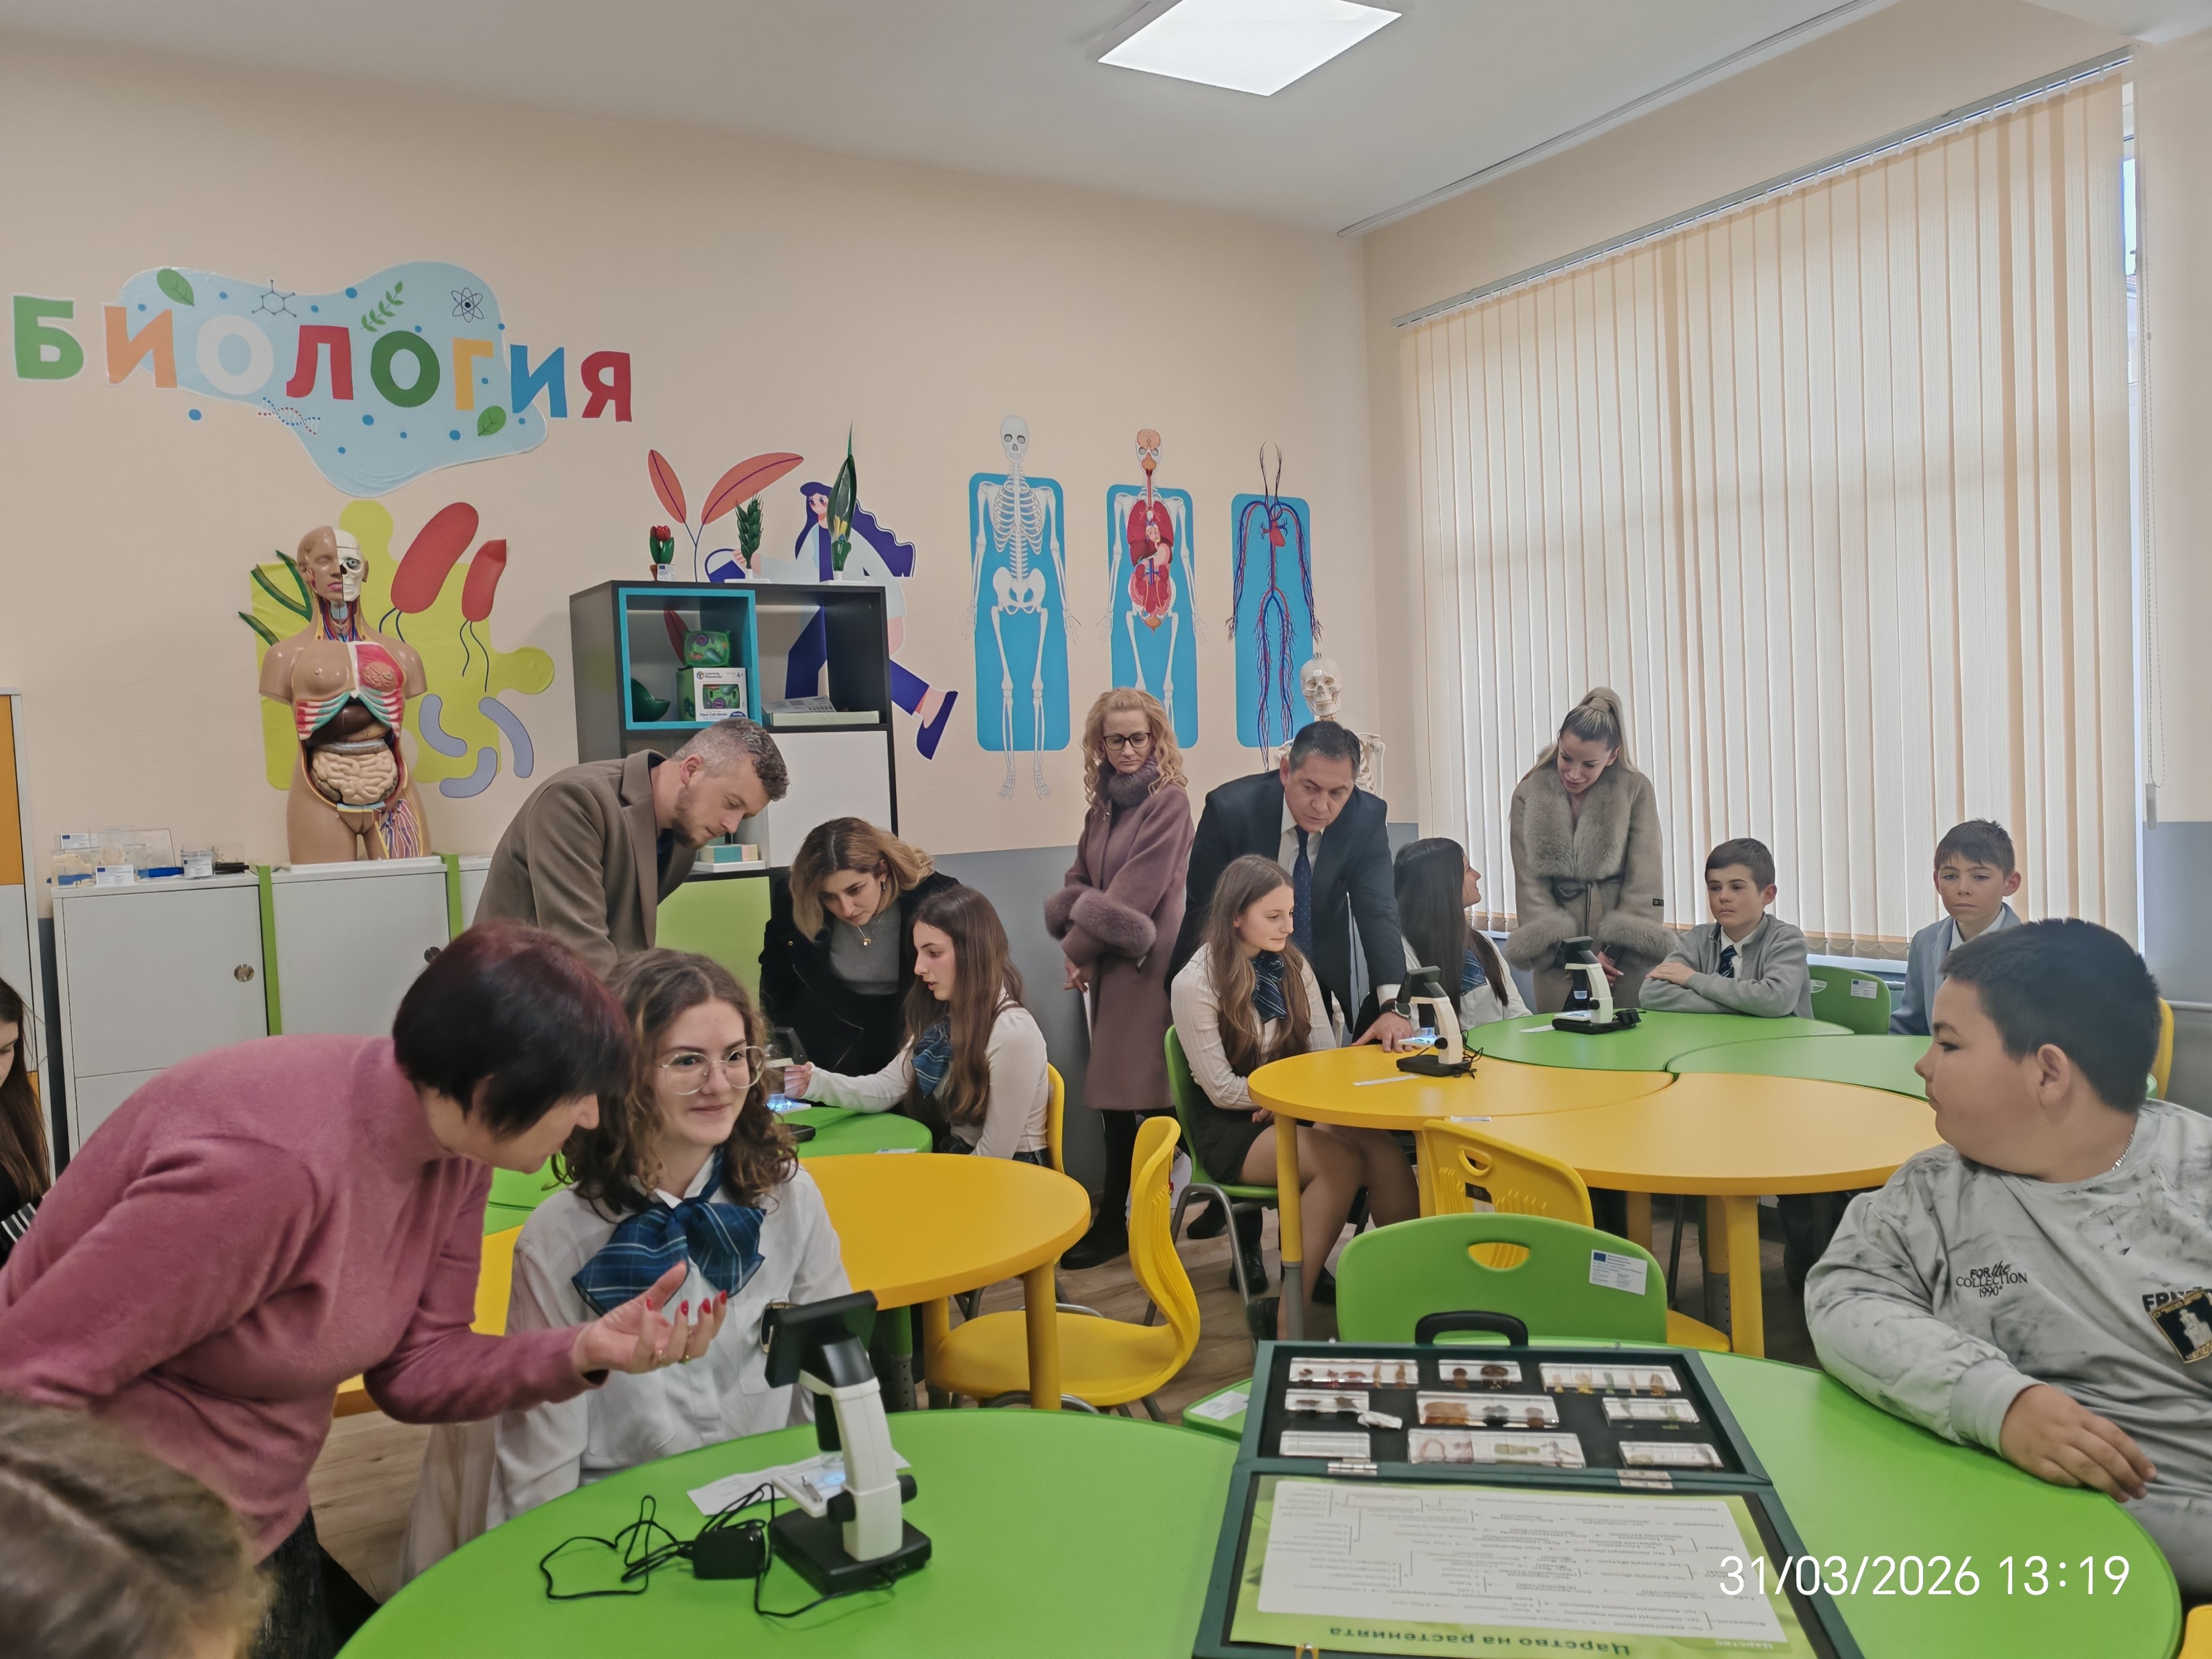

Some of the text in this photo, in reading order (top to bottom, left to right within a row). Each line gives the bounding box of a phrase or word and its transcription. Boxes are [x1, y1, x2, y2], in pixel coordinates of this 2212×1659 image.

[13, 295, 633, 422] БИОЛОГИЯ
[1956, 1272, 2028, 1288] COLLECTION
[1970, 1260, 2011, 1279] FOR the
[1329, 1627, 1631, 1656] Царство на растенията
